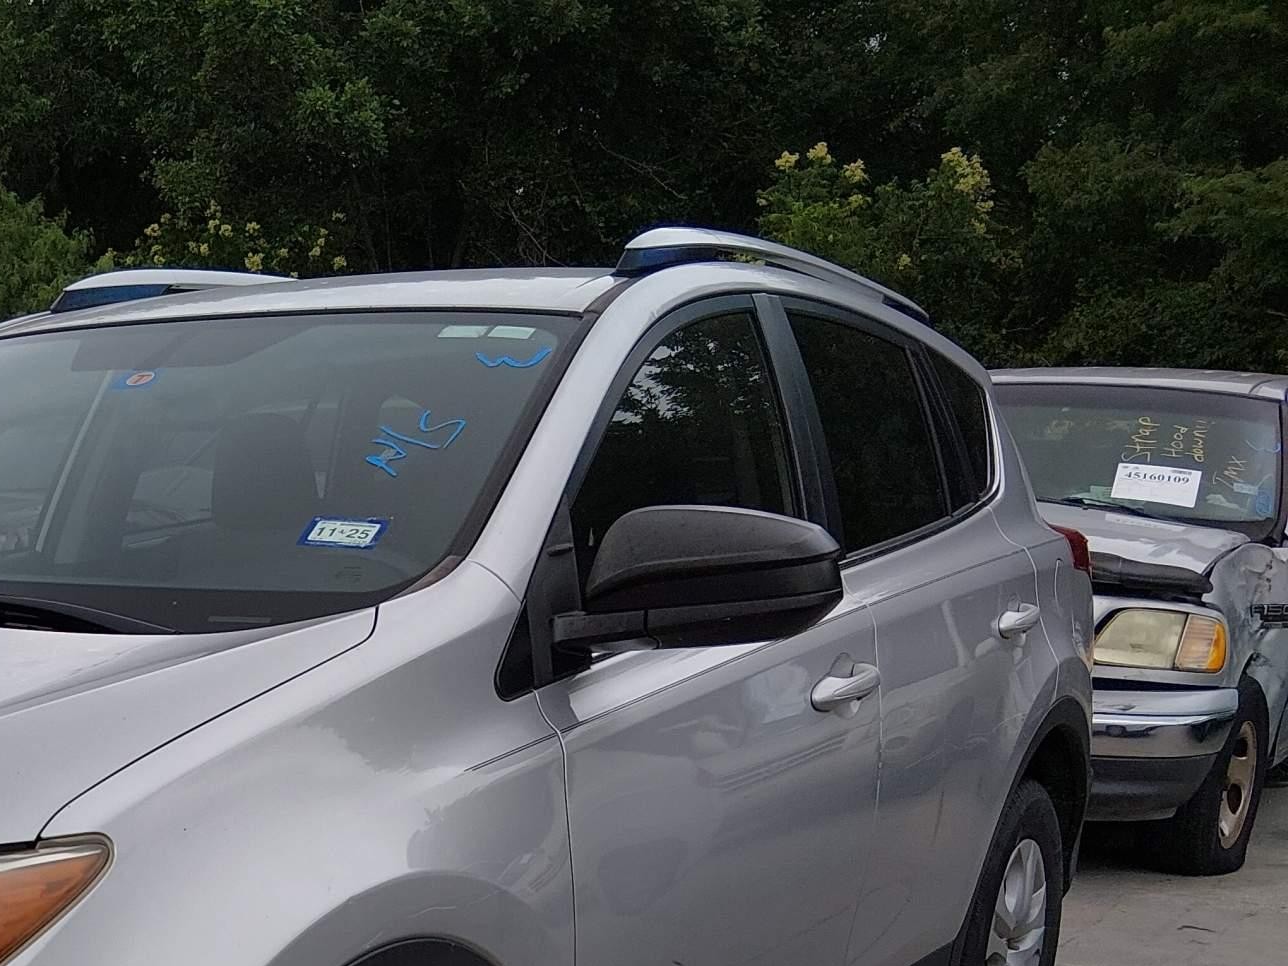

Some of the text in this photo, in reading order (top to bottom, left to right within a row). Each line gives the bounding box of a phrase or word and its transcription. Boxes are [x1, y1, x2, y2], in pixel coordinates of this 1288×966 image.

[1121, 416, 1160, 463] Strap
[1160, 425, 1189, 458] Hood
[1124, 471, 1190, 484] 45160109
